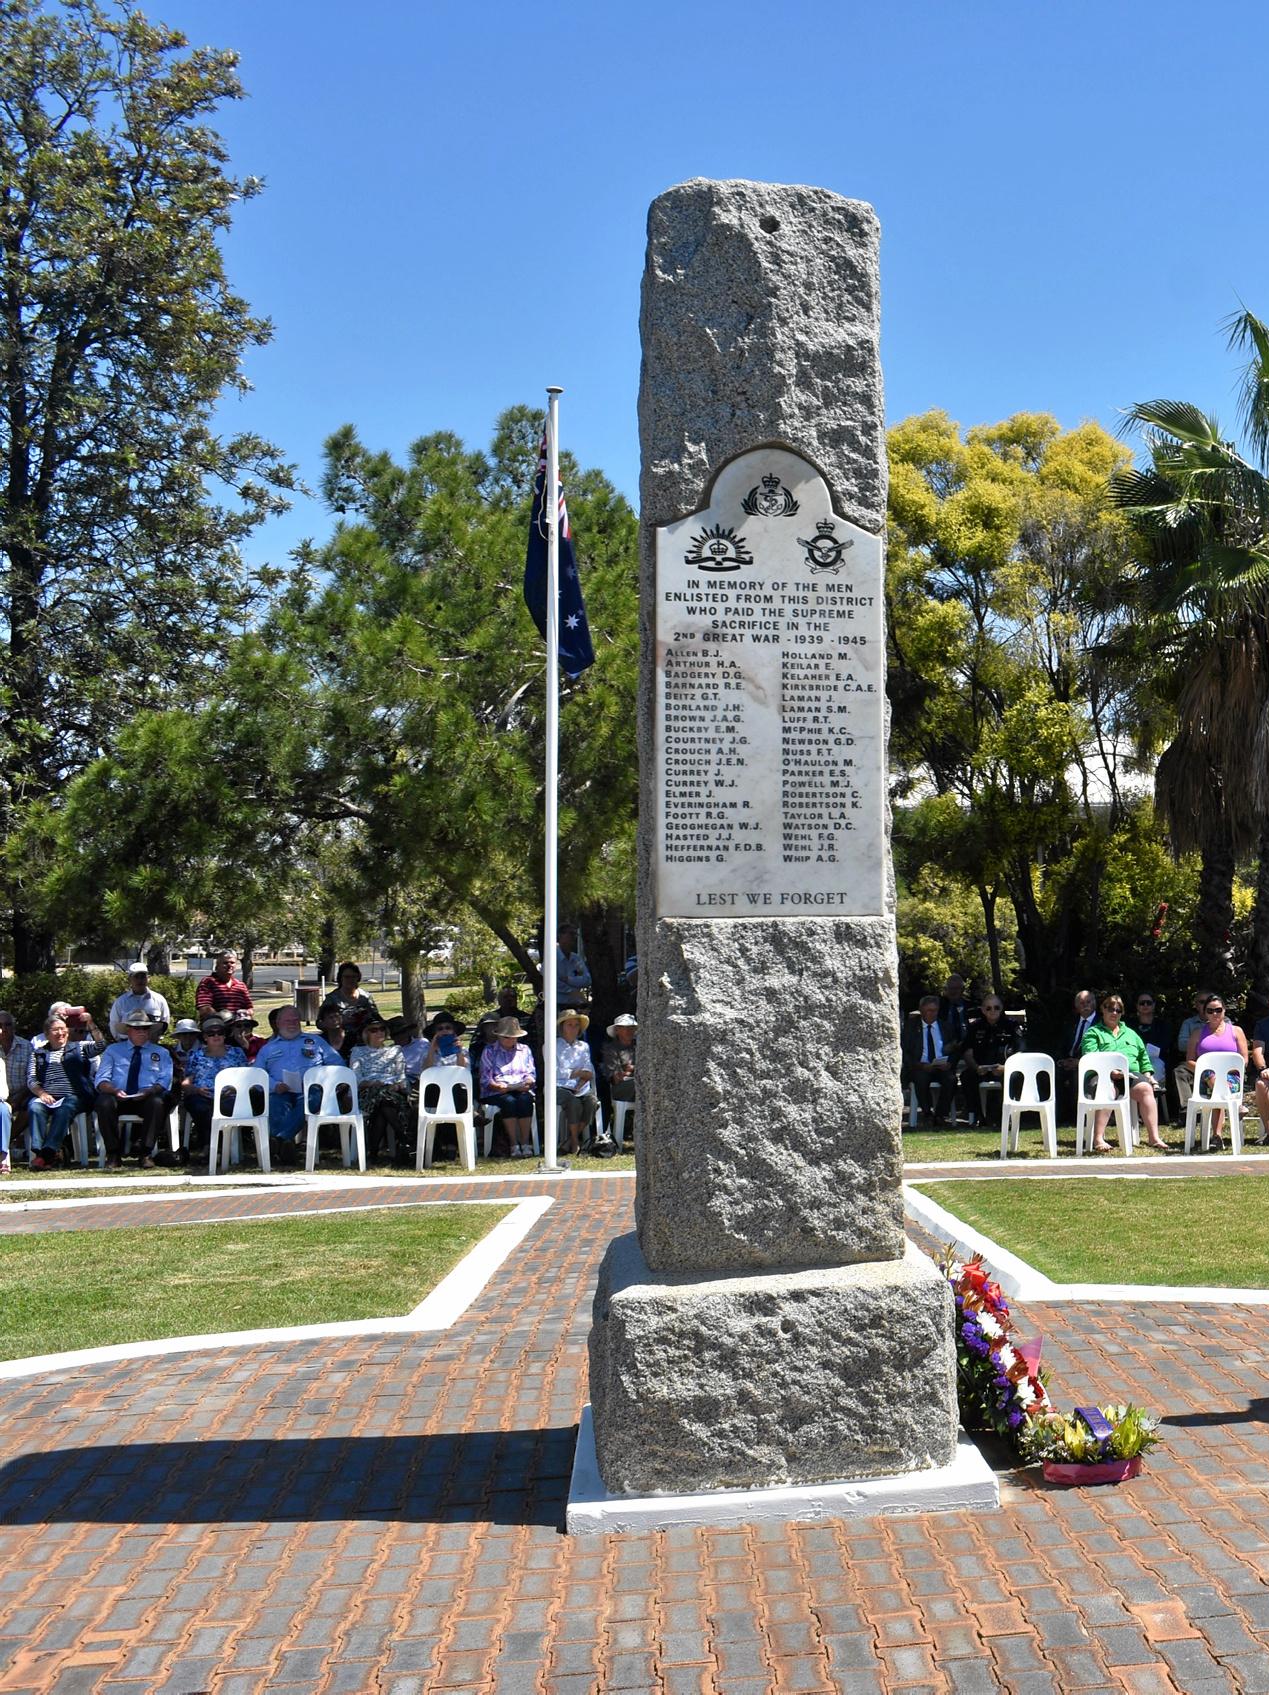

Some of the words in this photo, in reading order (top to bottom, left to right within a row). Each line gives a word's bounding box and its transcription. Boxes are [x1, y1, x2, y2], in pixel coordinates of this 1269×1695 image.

[687, 580, 700, 589] IN
[707, 580, 765, 591] MEMORY
[772, 582, 788, 591] OF
[795, 583, 819, 592] THE
[825, 583, 854, 593] MEN
[665, 592, 729, 603] ENLISTED
[736, 594, 774, 604] FROM
[781, 595, 809, 605] THIS
[816, 596, 874, 607] DISTRICT
[686, 606, 722, 616] WHO
[725, 607, 754, 617] PAID
[761, 608, 785, 618] THE
[792, 609, 855, 619] SUPREME
[711, 620, 780, 630] SACRIFICE
[787, 621, 799, 631] IN
[807, 622, 830, 632] THE
[673, 632, 696, 642] 2ND
[702, 633, 745, 644] GREAT
[751, 634, 780, 644] WAR
[665, 649, 698, 657] ALLEN
[702, 649, 723, 658] B.J.
[782, 651, 833, 660] HOLLAND
[838, 652, 852, 661] M.
[665, 660, 711, 668] ARTHUR
[717, 660, 741, 669] H.A.
[782, 662, 820, 670] KEILAR
[825, 662, 835, 671] E.
[665, 670, 717, 679] BADGERY
[722, 671, 745, 680] D.G.
[782, 672, 830, 681] KELAHER
[835, 673, 858, 682] E.A.
[665, 681, 719, 690] BARNARD
[724, 682, 745, 691] R.E.
[782, 683, 839, 692] KIRKBRIDE
[843, 684, 877, 693] C.A.E.
[665, 692, 696, 701] BEITZ
[701, 692, 721, 701] G.T.
[782, 694, 821, 702] LAMAN
[826, 695, 836, 703] J.
[665, 703, 718, 712] BORLAND
[782, 705, 821, 713] LAMAN
[826, 705, 851, 714] S.M.
[665, 714, 706, 722] BROWN
[710, 714, 745, 723] J.A.G.
[782, 716, 808, 724] LUFF
[812, 716, 831, 724] R.T.
[665, 725, 710, 733] BUCKBY
[715, 725, 739, 734] E.M.
[828, 727, 850, 735] K.C.
[665, 735, 725, 745] COURTNEY
[729, 736, 751, 745] J.G.
[782, 737, 829, 746] NEWBON
[834, 738, 857, 746] G.D.
[665, 747, 711, 755] CROUCH
[716, 747, 740, 756] A.H.
[782, 748, 812, 757] NUSS
[665, 757, 711, 766] CROUCH
[716, 758, 748, 766] J.E.N.
[843, 759, 857, 767] M.
[665, 768, 709, 777] CURREY
[714, 769, 724, 777] J.
[782, 769, 824, 777] PARKER
[829, 769, 850, 777] E.S.
[665, 779, 709, 787] CURREY
[714, 780, 738, 788] W.J.
[782, 780, 825, 788] POWELL
[830, 780, 853, 788] M.J.
[665, 790, 701, 798] ELMER
[706, 790, 715, 798] J.
[782, 790, 846, 799] ROBERTSON
[851, 791, 862, 799] C.
[665, 801, 738, 809] EVERINGHAM
[743, 801, 753, 809] R.
[782, 801, 846, 809] ROBERTSON
[851, 801, 862, 809] K.
[665, 811, 701, 820] FOOTT
[706, 811, 729, 820] R.G.
[782, 811, 824, 820] TAYLOR
[828, 812, 850, 820] L.A.
[665, 822, 734, 831] GEOGHEGAN
[739, 822, 763, 831] W.J.
[782, 822, 829, 831] WATSON
[833, 822, 856, 831] D.C.
[665, 833, 710, 841] HASTED
[715, 833, 735, 841] J.J.
[782, 833, 813, 841] WEHL
[818, 833, 838, 841] F.G.
[665, 843, 730, 852] HEFFERNAN
[735, 843, 766, 852] F.D.B.
[782, 843, 813, 852] WEHL
[818, 844, 838, 852] J.R.
[665, 854, 711, 863] HIGGINS
[716, 854, 727, 863] G.
[782, 854, 811, 863] WHIP
[816, 854, 839, 863] A.G.
[696, 893, 738, 906] LEST
[745, 893, 773, 905] WE
[780, 892, 848, 905] FORGET
